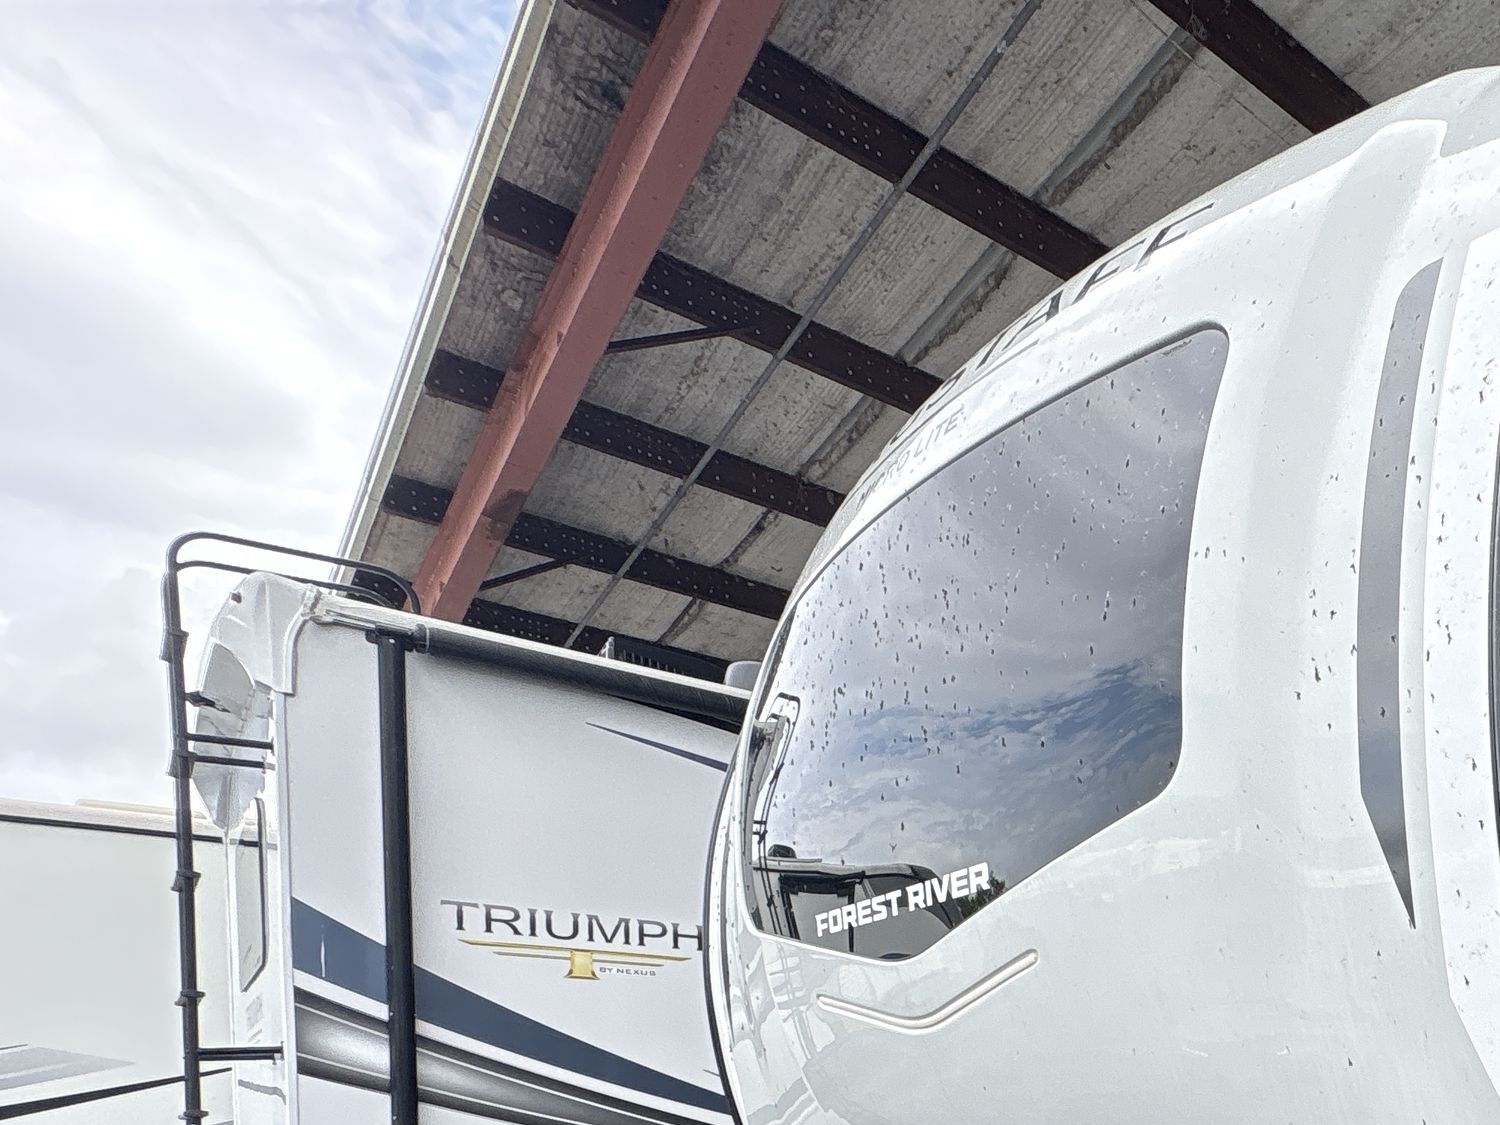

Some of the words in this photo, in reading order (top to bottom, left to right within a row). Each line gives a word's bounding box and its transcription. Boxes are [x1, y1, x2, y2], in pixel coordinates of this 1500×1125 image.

[440, 899, 703, 952] TRIUMPH
[815, 889, 902, 938] FOREST
[905, 861, 991, 912] RIVER
[599, 966, 614, 975] BY
[616, 967, 657, 977] NEXUS
